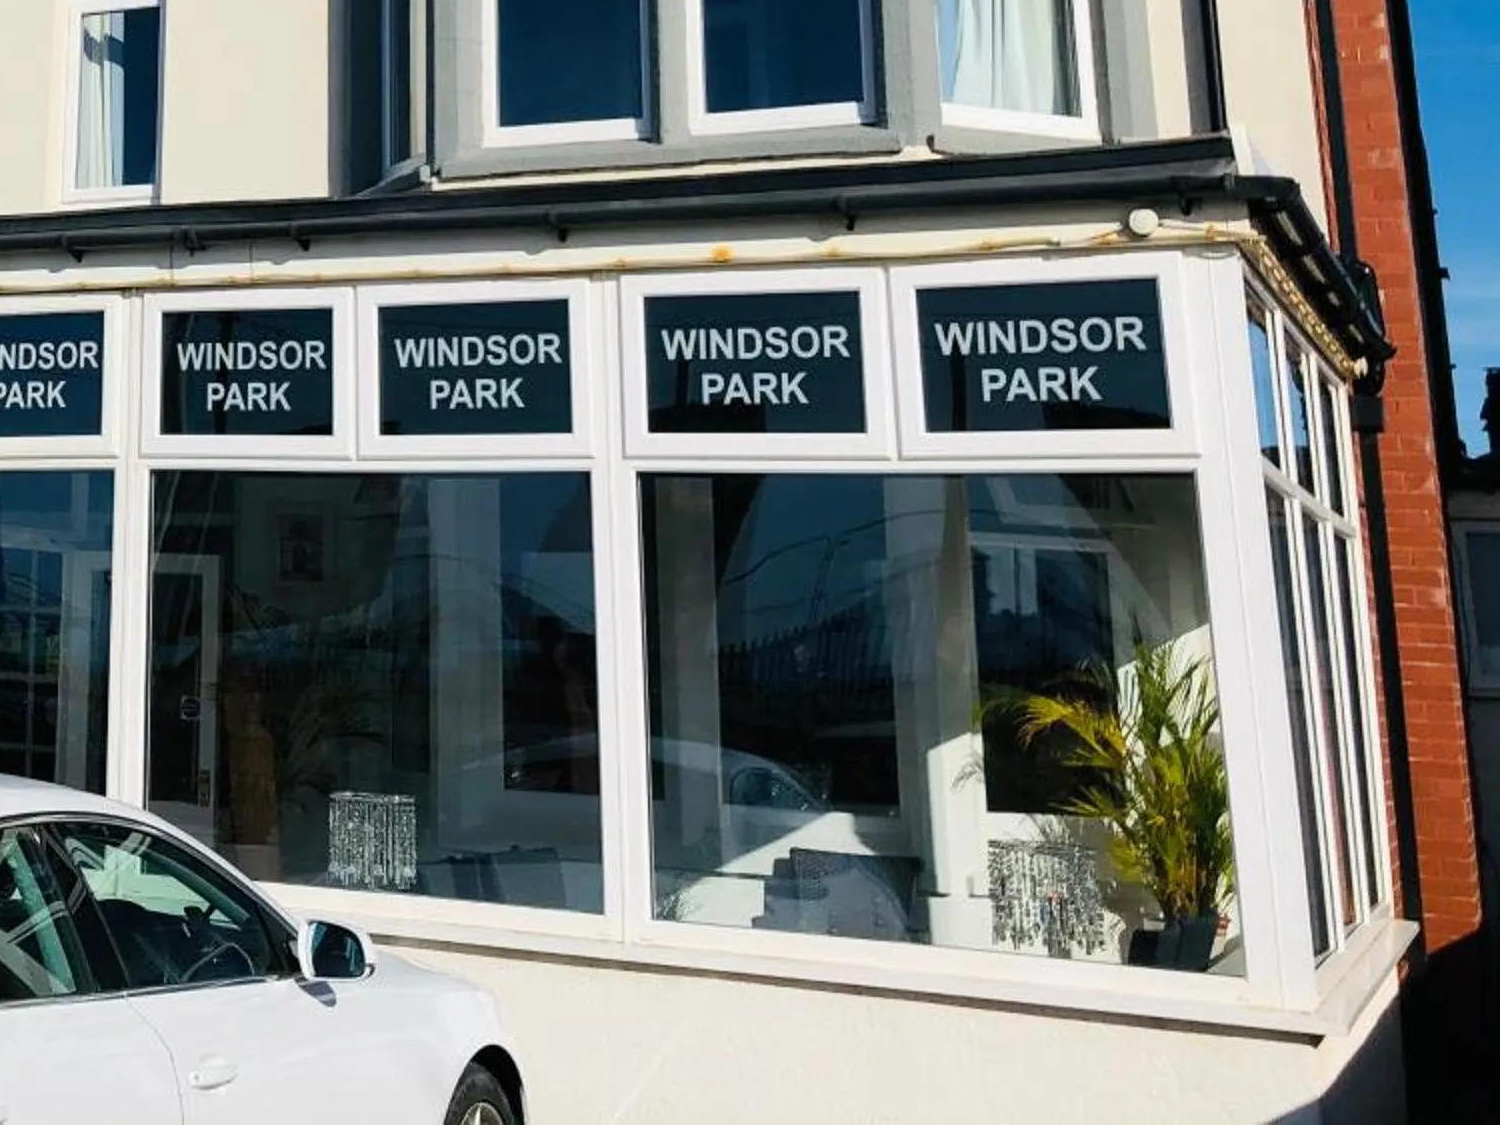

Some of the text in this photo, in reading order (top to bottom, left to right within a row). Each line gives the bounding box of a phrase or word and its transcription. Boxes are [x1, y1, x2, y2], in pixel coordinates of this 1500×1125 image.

[394, 333, 563, 369] WINDSOR
[661, 325, 852, 361] WINDSOR
[934, 315, 1148, 357] WINDSOR
[177, 340, 327, 372] WINDSOR
[206, 381, 291, 412] PARK
[429, 377, 525, 411] PARK
[700, 371, 809, 405] PARK
[981, 365, 1103, 403] PARK
